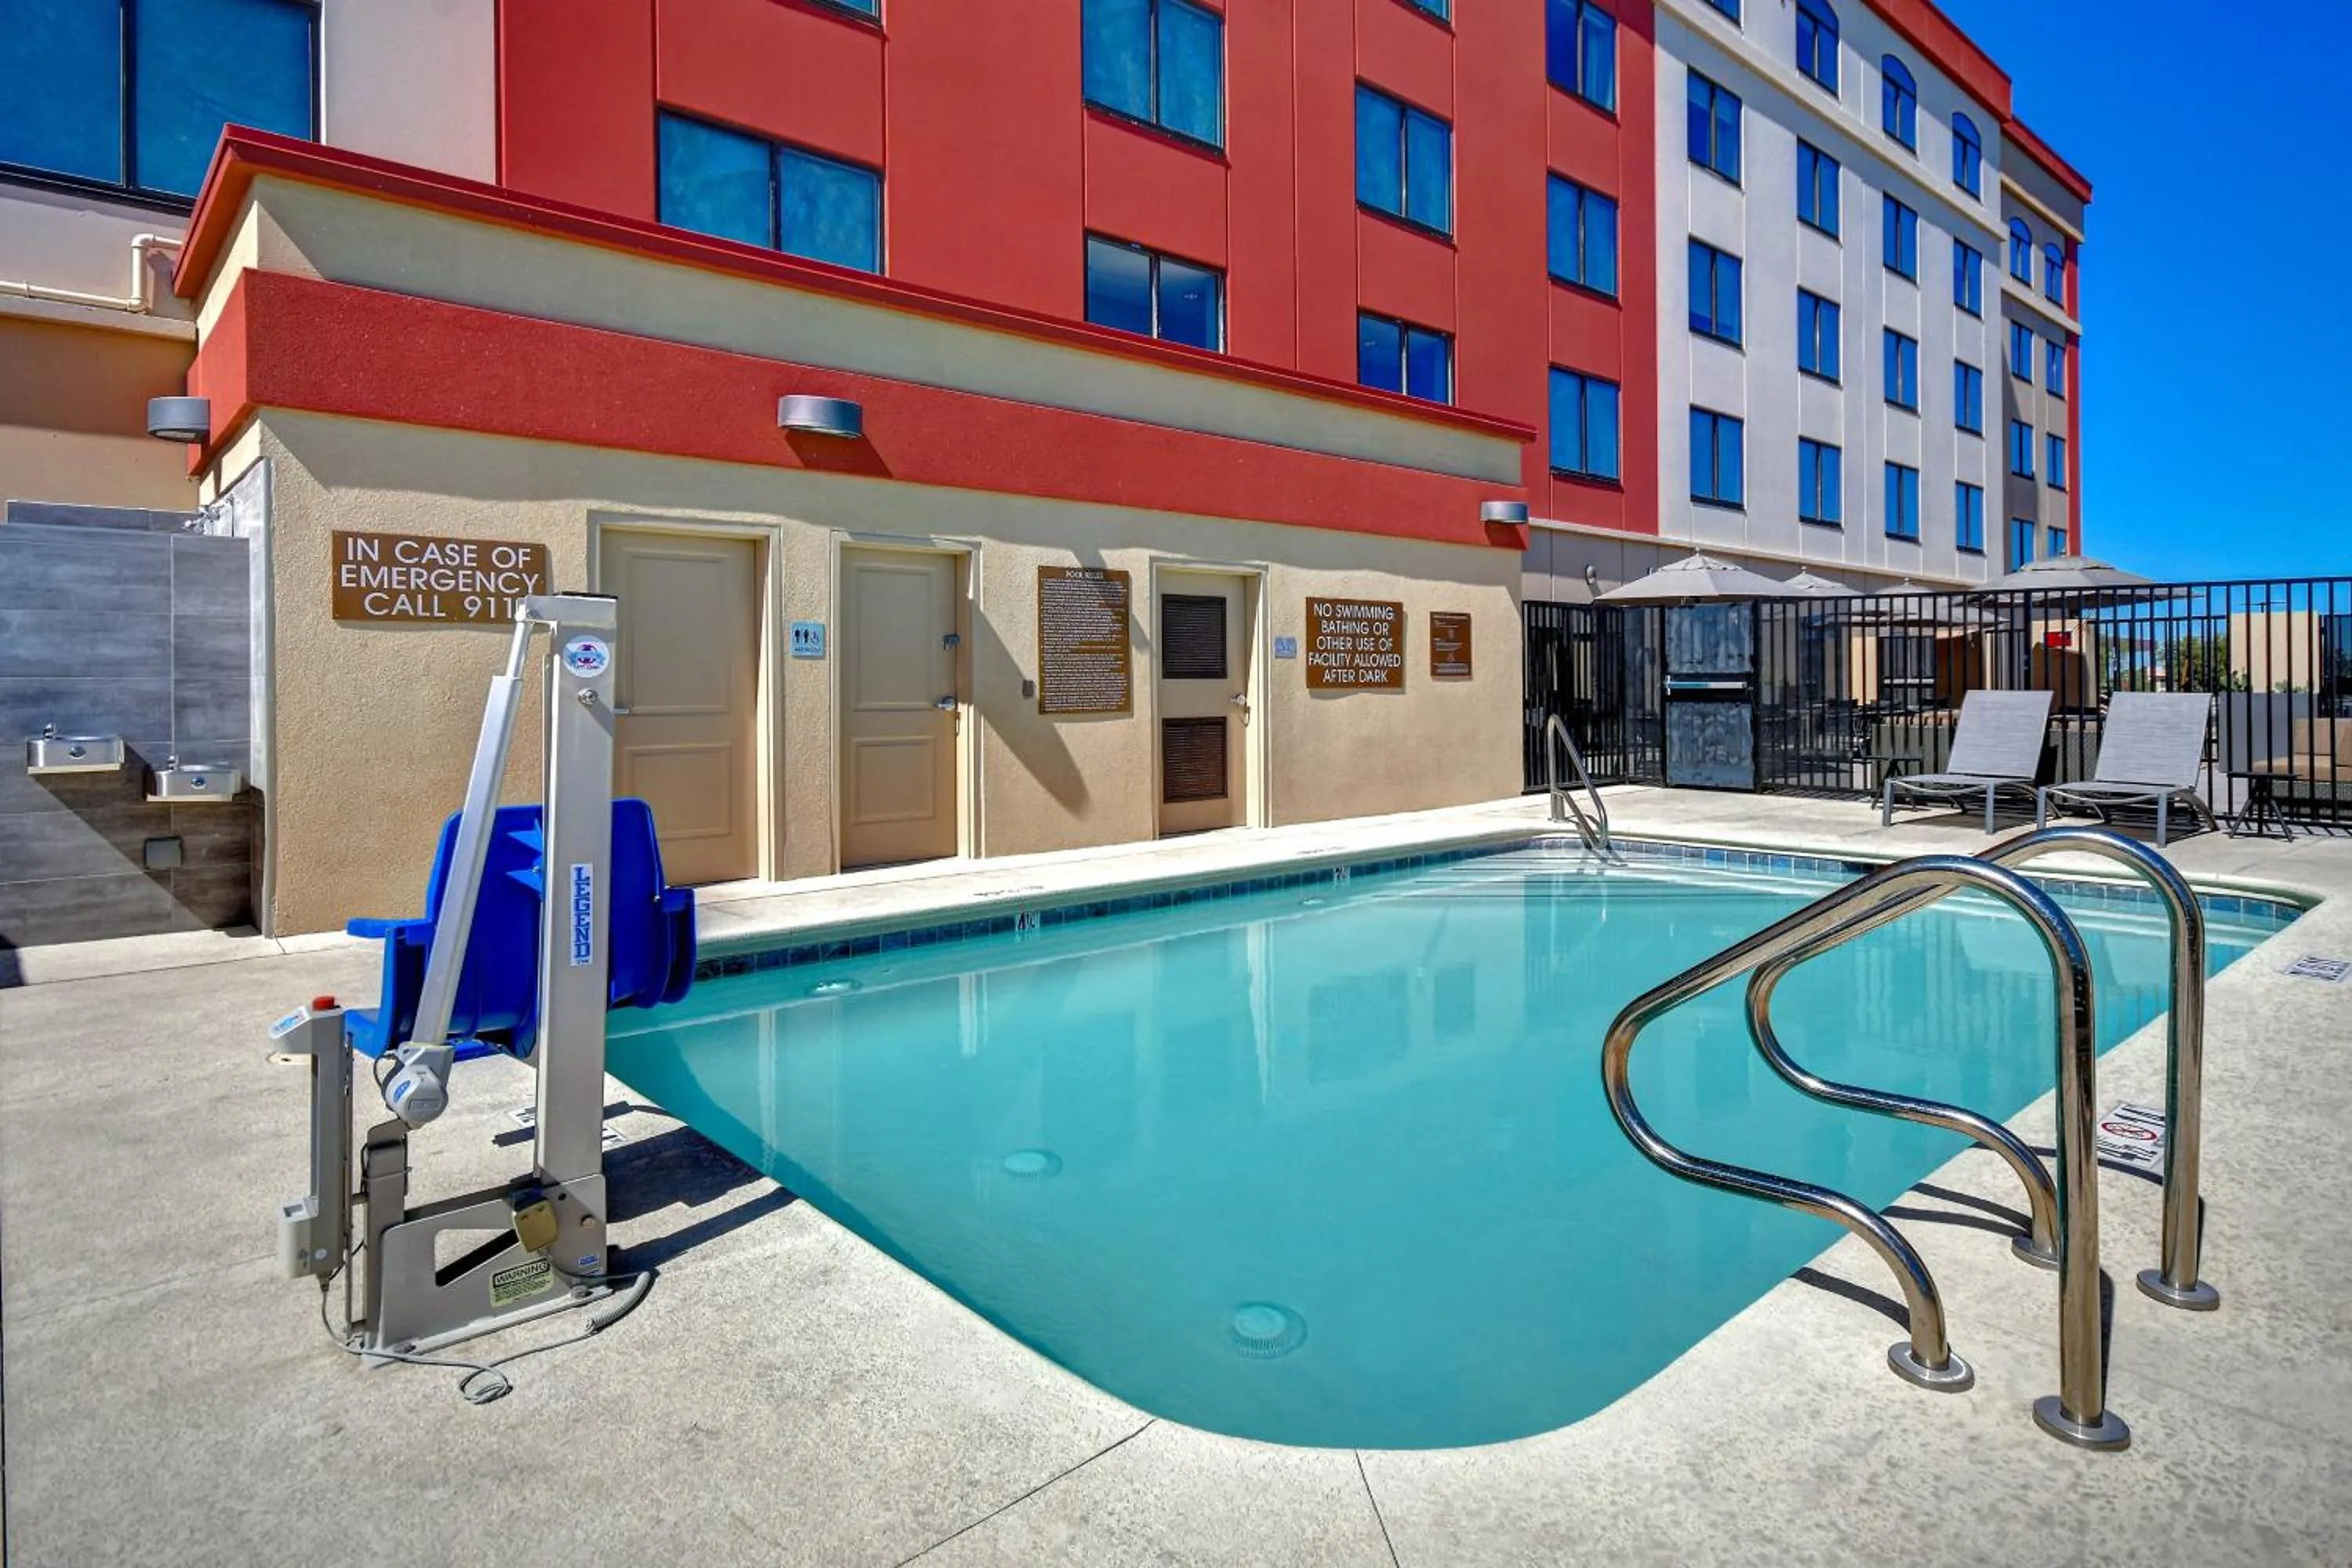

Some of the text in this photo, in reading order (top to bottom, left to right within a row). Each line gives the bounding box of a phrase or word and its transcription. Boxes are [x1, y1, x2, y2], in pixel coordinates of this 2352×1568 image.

[347, 537, 531, 568] IN CASE OF
[341, 564, 539, 593] EMERGENCY
[364, 592, 512, 619] CALL 911
[1314, 603, 1394, 620] NO SWIMMING
[1321, 621, 1390, 636] BATHING OR
[1316, 636, 1393, 652] OTHER USE OF
[1308, 652, 1401, 667] FACILITY ALLOWED
[1323, 670, 1388, 683] AFTER DARK
[575, 866, 590, 958] LEGEND
[496, 1260, 548, 1283] WARNING
